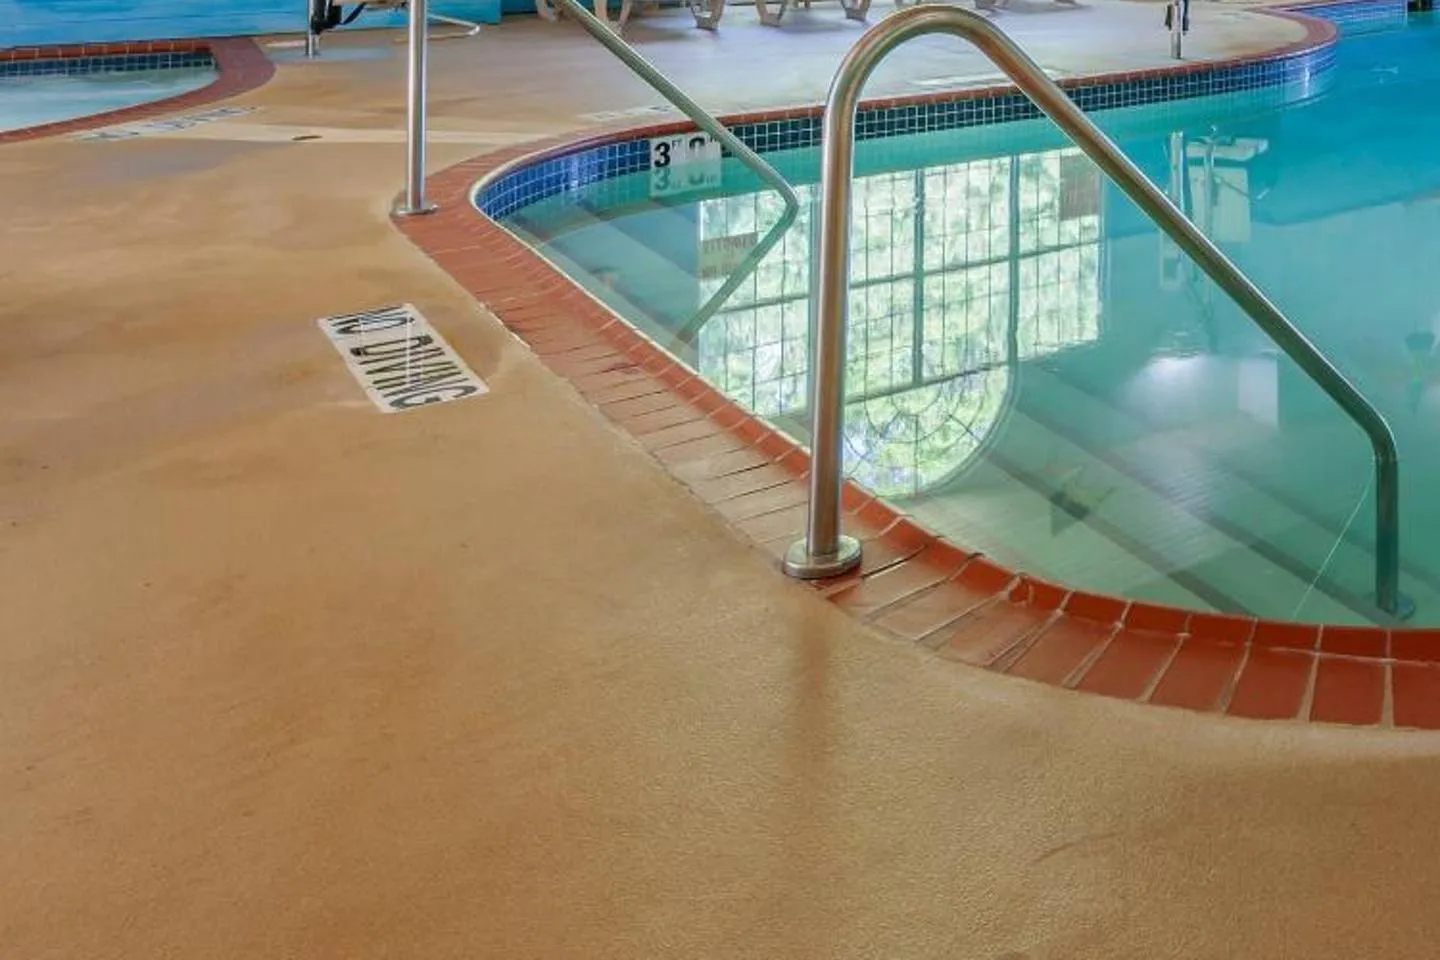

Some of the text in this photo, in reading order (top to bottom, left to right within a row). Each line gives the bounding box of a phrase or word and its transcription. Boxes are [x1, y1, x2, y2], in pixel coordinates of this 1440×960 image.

[654, 141, 671, 168] 3
[326, 306, 479, 410] NO DIVING
